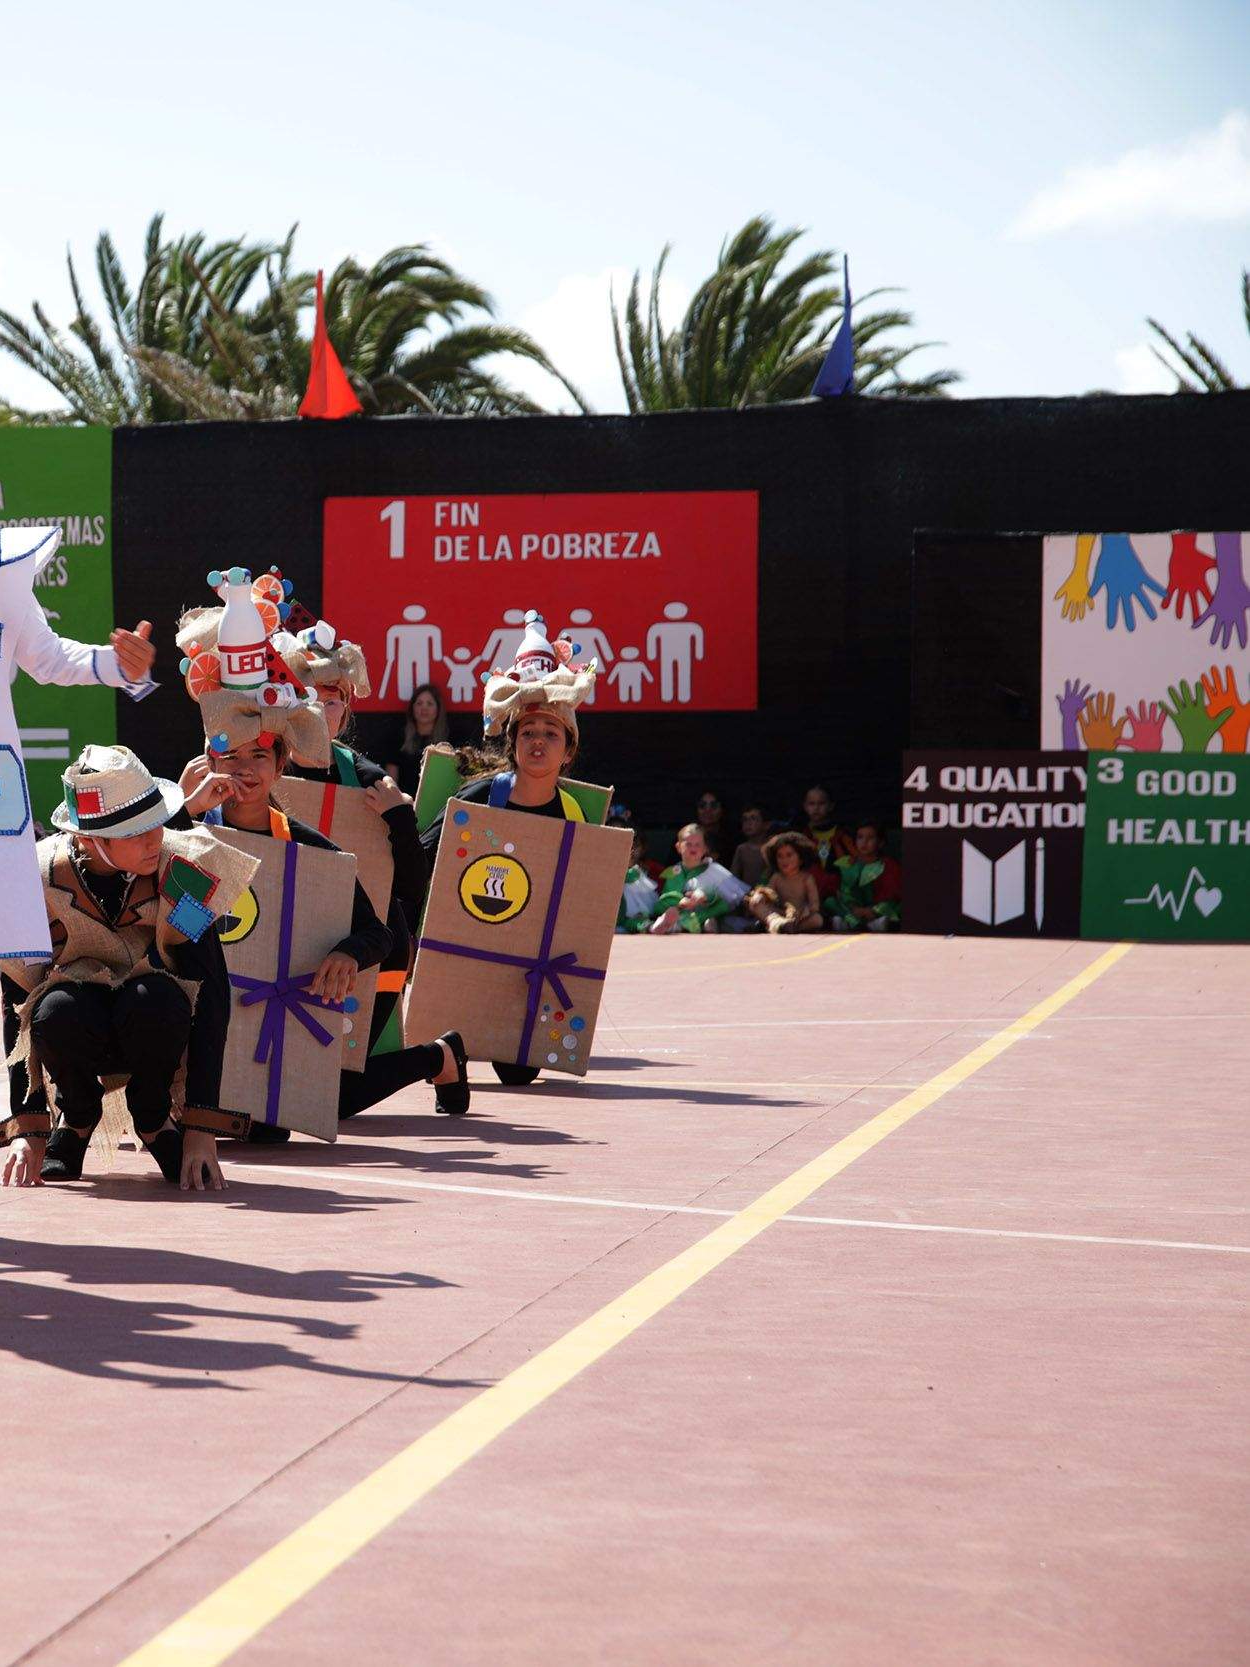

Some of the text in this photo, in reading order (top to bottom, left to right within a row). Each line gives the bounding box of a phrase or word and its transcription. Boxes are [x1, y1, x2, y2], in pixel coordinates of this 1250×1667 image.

[434, 501, 480, 527] FIN
[379, 500, 406, 559] 1
[434, 531, 661, 562] DE LA POBREZA
[903, 765, 1087, 793] 4 QUALITY
[1096, 757, 1237, 797] 3 GOOD
[1107, 818, 1250, 845] HEALTH
